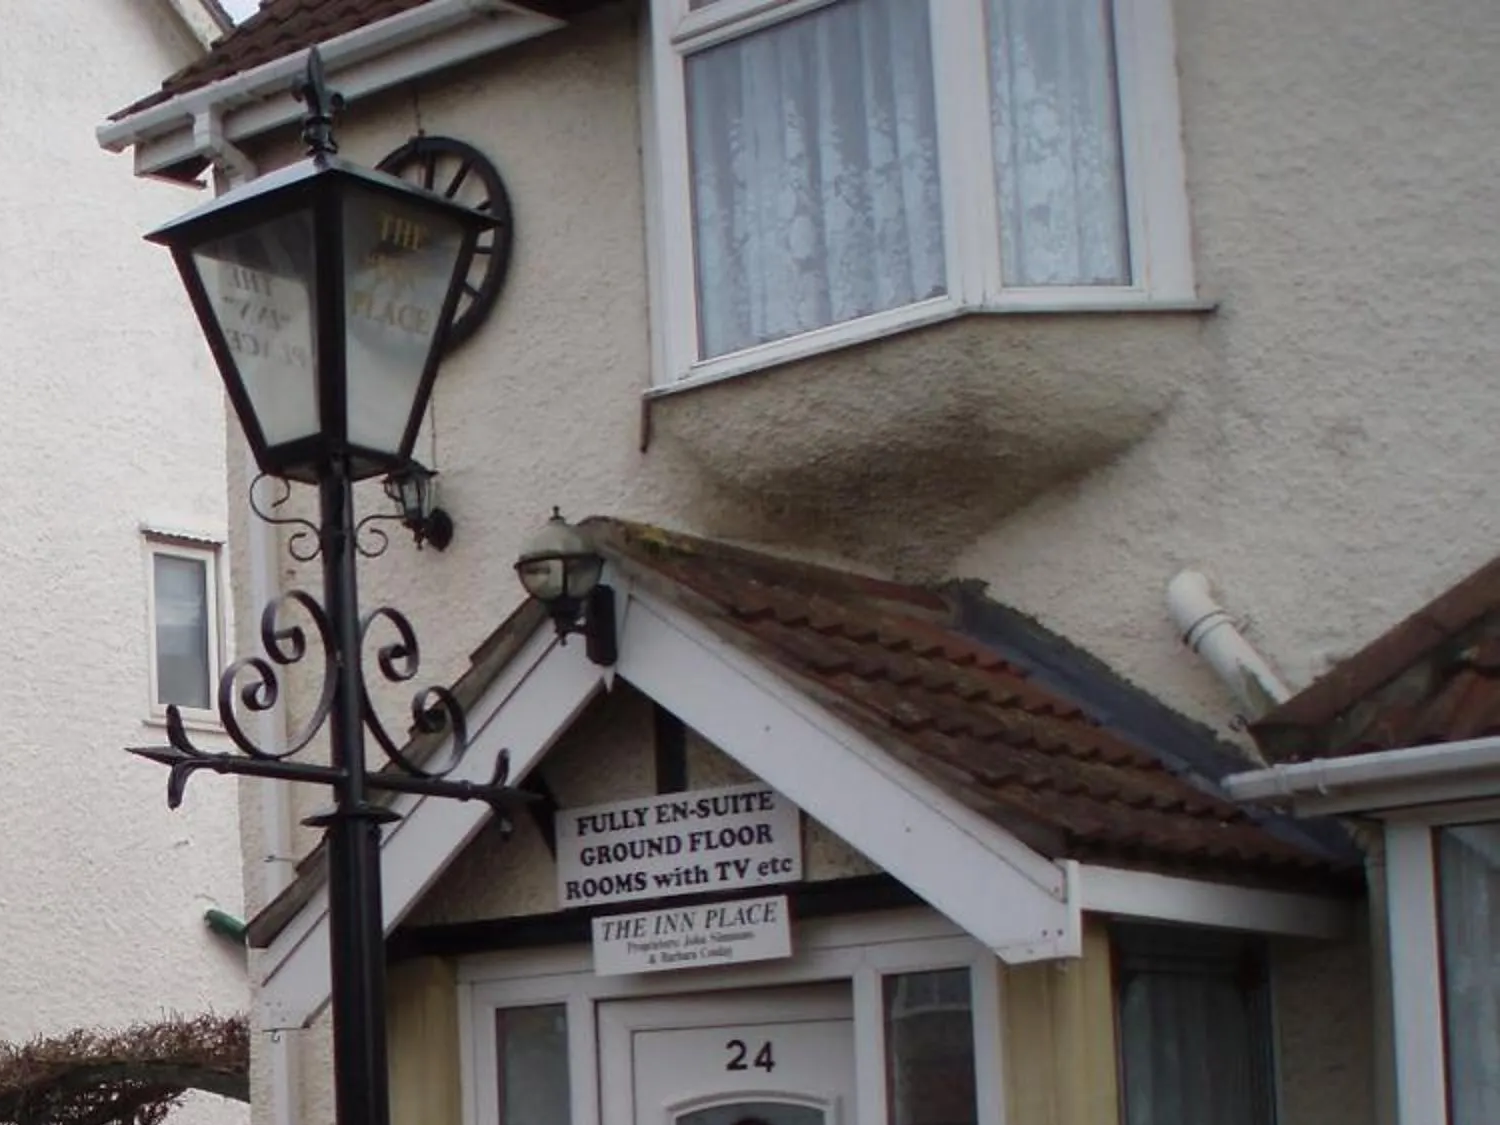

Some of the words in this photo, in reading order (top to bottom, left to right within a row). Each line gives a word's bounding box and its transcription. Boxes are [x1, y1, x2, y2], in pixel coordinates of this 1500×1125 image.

[576, 807, 649, 837] FULLY
[655, 791, 775, 825] EN-SUITE
[580, 835, 682, 867] GROUND
[689, 823, 773, 852] FLOOR
[565, 872, 647, 900] ROOMS
[653, 865, 709, 889] with
[715, 858, 752, 882] TV
[757, 856, 793, 878] etc
[602, 917, 647, 941] THE
[653, 911, 696, 935] INN
[705, 902, 778, 929] PLACE
[726, 1039, 776, 1072] 24
